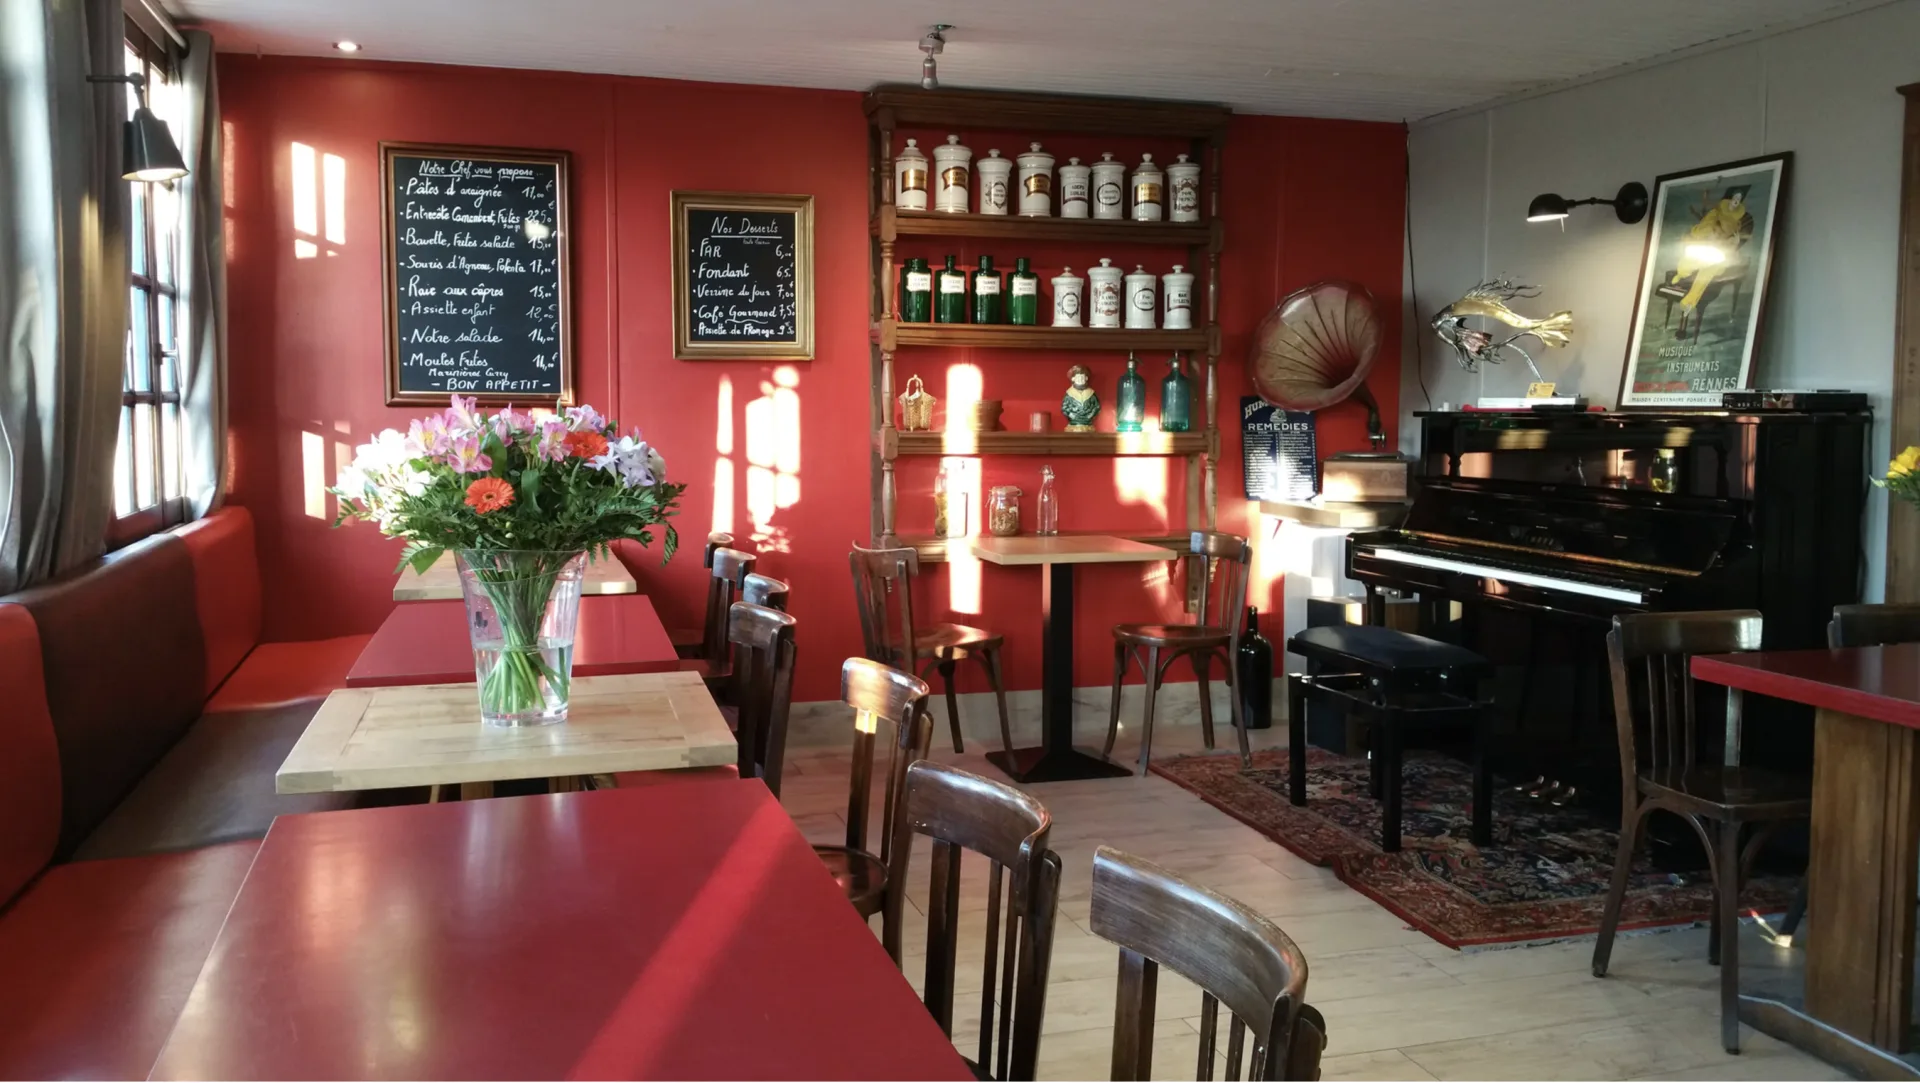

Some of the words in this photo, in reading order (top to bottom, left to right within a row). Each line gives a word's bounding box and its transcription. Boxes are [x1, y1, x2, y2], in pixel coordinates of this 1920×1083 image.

[419, 160, 445, 175] Notre
[450, 160, 471, 178] Chef
[406, 177, 439, 195] Pâtes
[406, 201, 450, 220] Entrecôte
[497, 208, 520, 223] Frites
[711, 216, 732, 234] Nos
[739, 217, 778, 234] Desserts
[453, 232, 477, 247] Frites
[480, 234, 515, 248] salade
[700, 238, 722, 257] FAR
[407, 255, 443, 270] Souris
[497, 258, 526, 274] Polenta
[698, 262, 750, 278] Fondant
[408, 275, 436, 297] Raie
[443, 286, 467, 295] aux
[471, 283, 504, 303] câpres
[697, 283, 734, 298] Verrine
[738, 284, 749, 296] du
[748, 280, 771, 303] jour
[411, 300, 458, 316] Assiette
[461, 303, 496, 324] enfant
[698, 305, 724, 324] Café
[729, 305, 777, 321] Gourmand
[410, 325, 451, 344] Notre
[455, 326, 503, 343] salade
[698, 322, 727, 336] Assiette
[729, 324, 741, 335] de
[410, 352, 454, 366] Moules
[459, 350, 488, 366] Frites
[1658, 346, 1694, 358] MUSIQUE
[485, 367, 508, 382] Curry
[1666, 360, 1720, 373] INSTRUMENTS
[447, 378, 478, 390] BON
[486, 379, 539, 391] APPETIT
[1691, 377, 1737, 391] RENNES
[1247, 422, 1308, 431] REMEDIES
